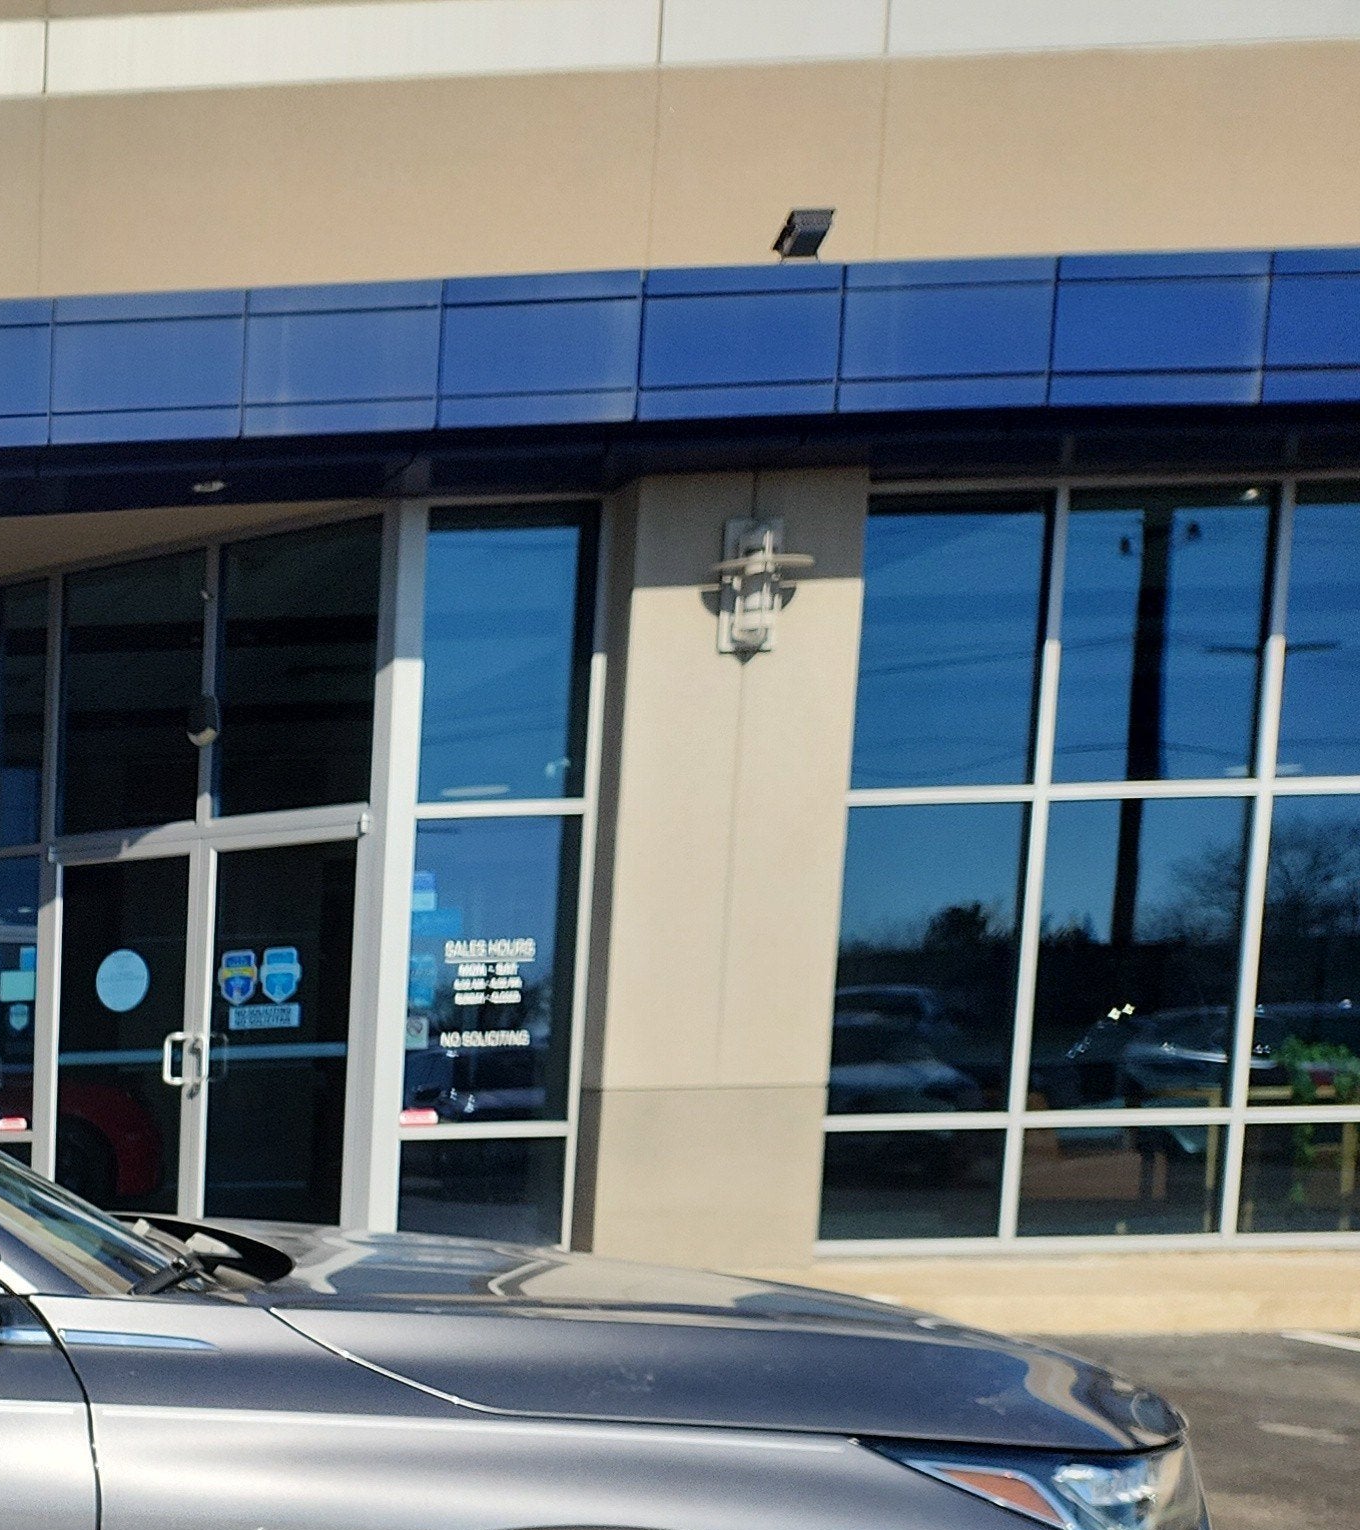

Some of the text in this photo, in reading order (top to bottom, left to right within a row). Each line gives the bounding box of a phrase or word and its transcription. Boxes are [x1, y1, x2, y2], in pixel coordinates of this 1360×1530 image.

[444, 938, 536, 957] SALES HOURS
[440, 1030, 530, 1047] NO SOLICITING
